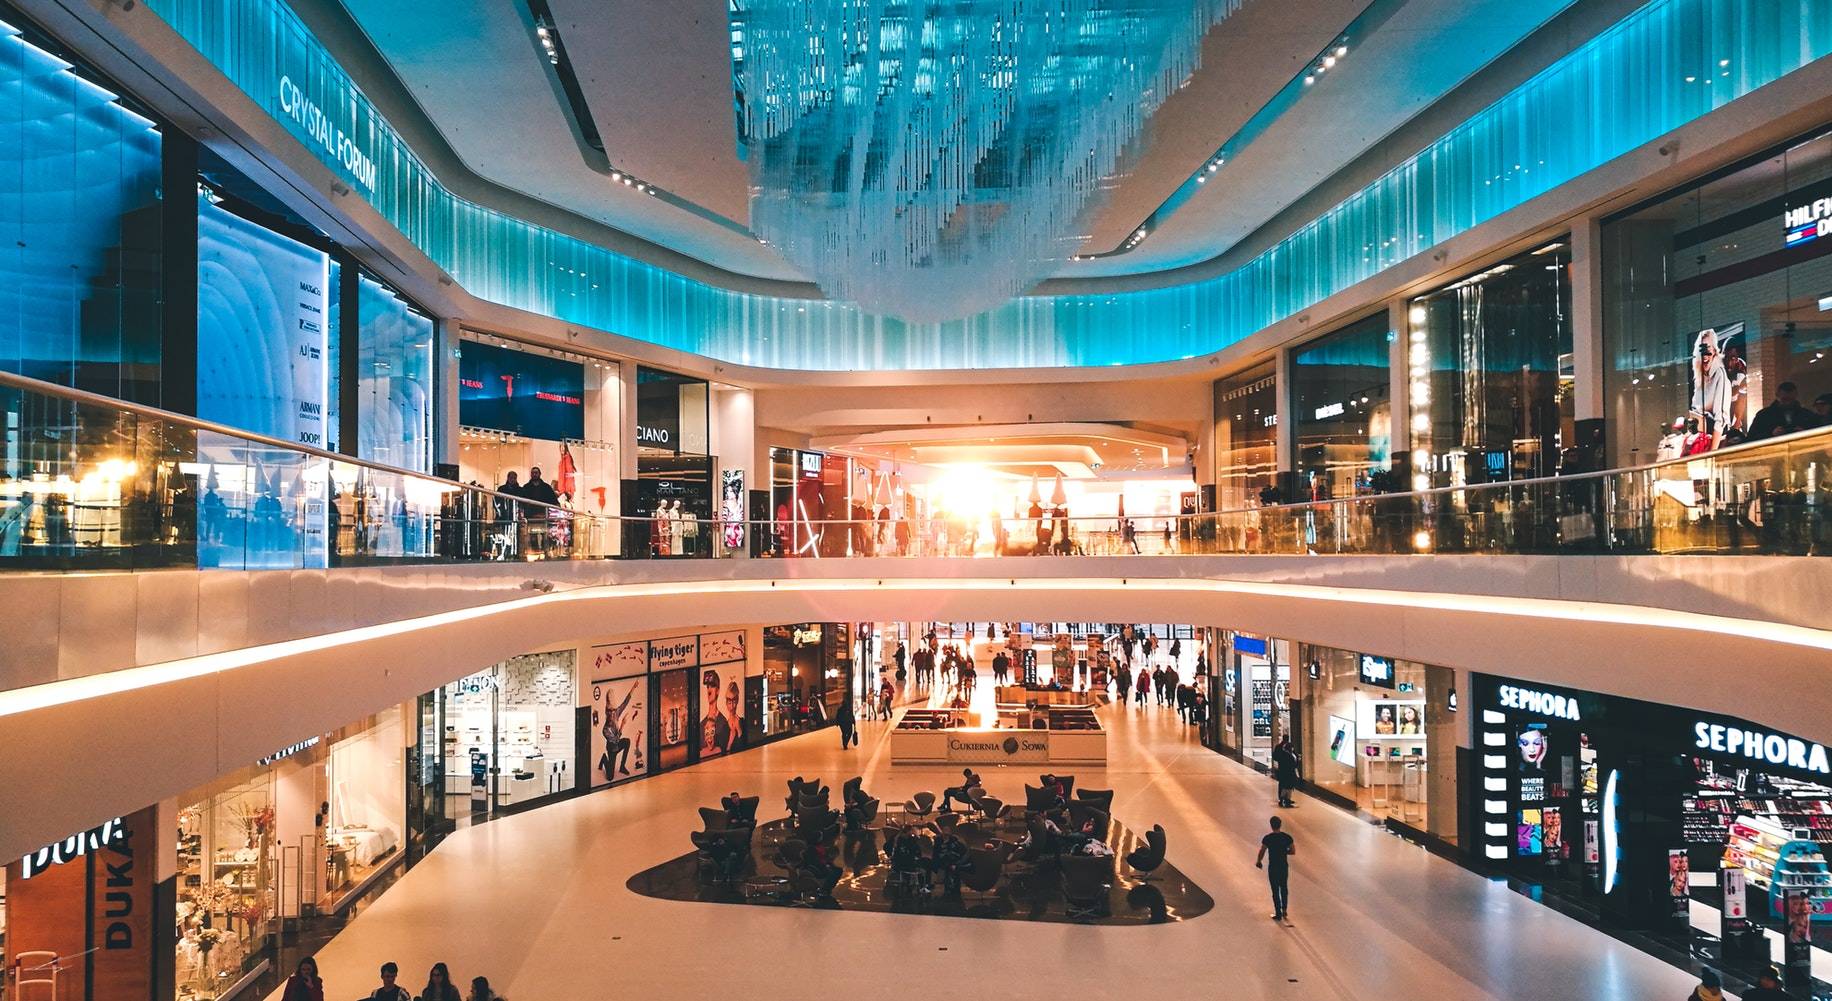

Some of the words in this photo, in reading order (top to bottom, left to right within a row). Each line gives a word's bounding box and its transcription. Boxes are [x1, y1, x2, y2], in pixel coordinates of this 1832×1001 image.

[279, 75, 336, 156] CRYSTAL
[337, 129, 376, 193] FORUM
[1785, 197, 1832, 228] HILFI
[1263, 414, 1278, 427] STE
[298, 432, 321, 445] JOOP!
[636, 426, 669, 443] CIANO
[651, 646, 673, 661] flying
[674, 643, 695, 657] tiger
[1499, 685, 1581, 721] SEPHORA
[1694, 721, 1831, 774] SEPHORA
[1521, 793, 1545, 801] BEATS
[105, 829, 134, 950] DUKA
